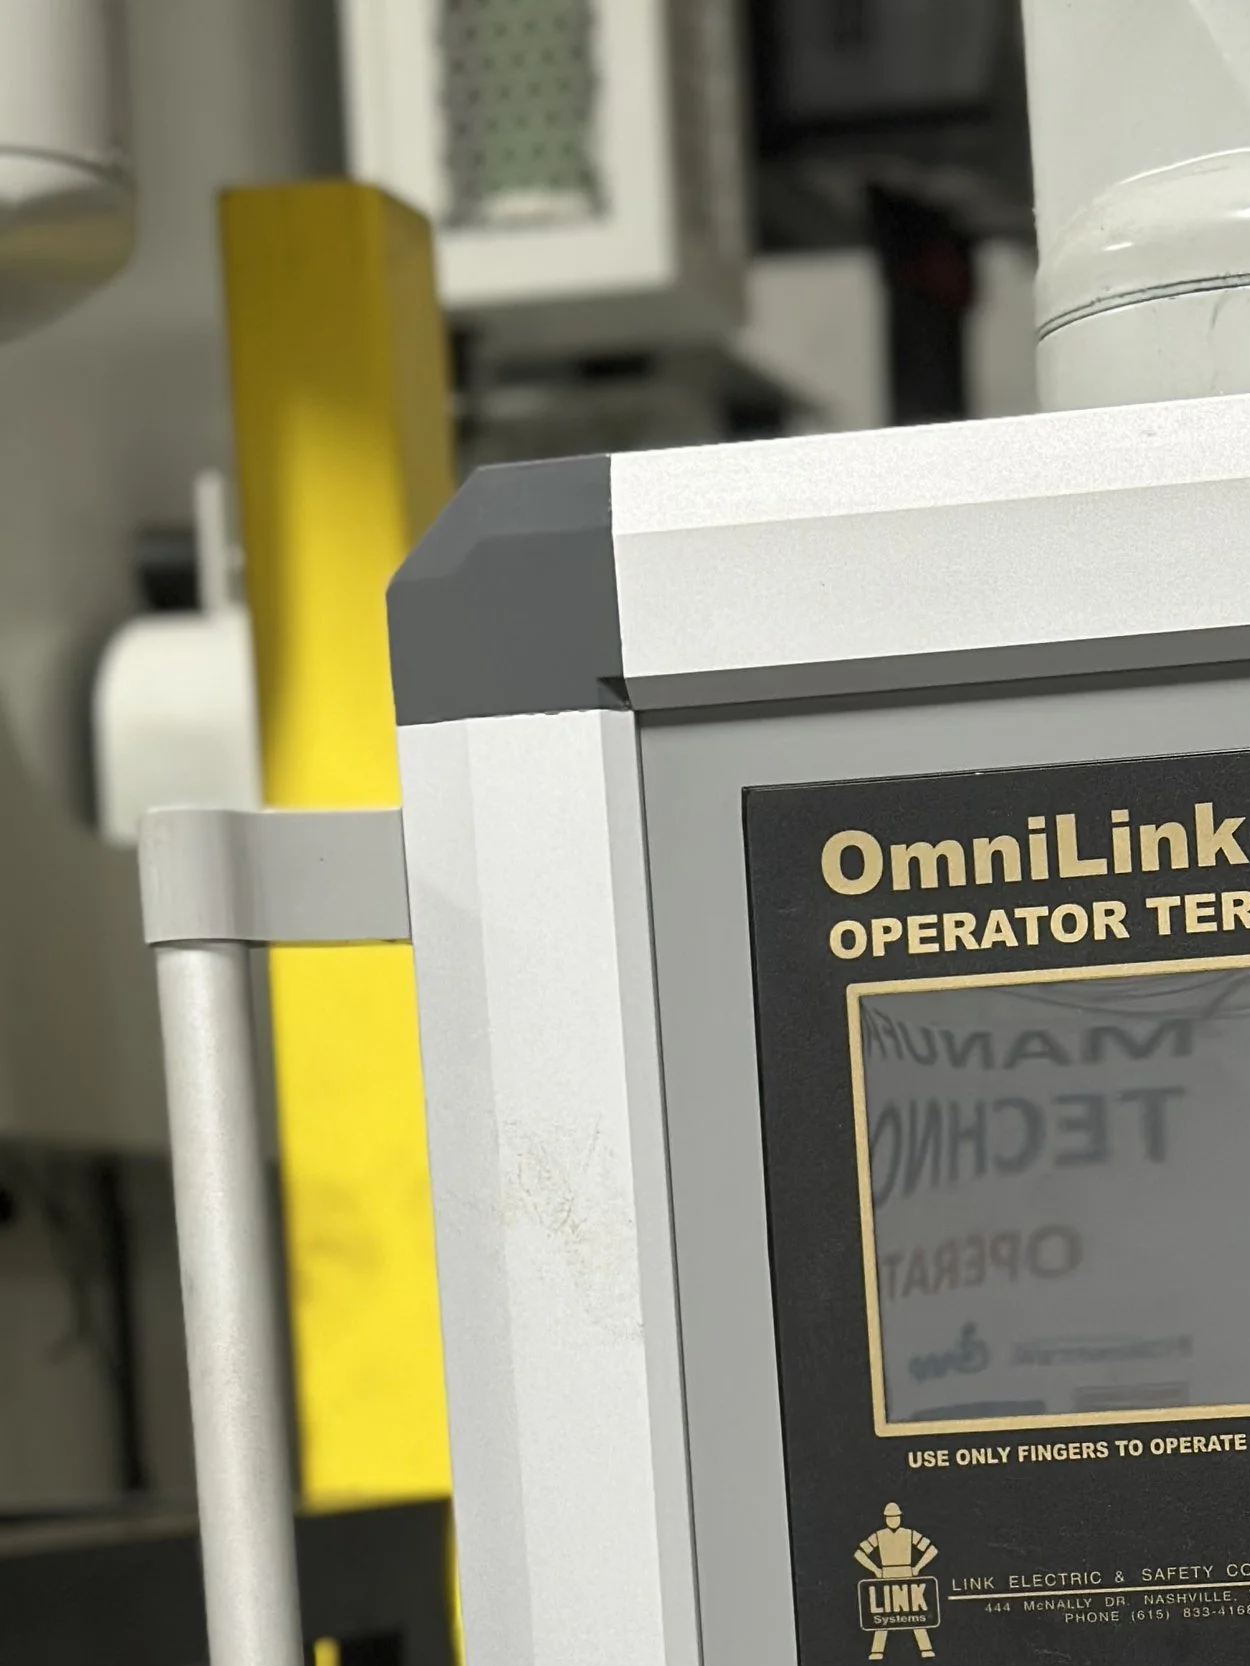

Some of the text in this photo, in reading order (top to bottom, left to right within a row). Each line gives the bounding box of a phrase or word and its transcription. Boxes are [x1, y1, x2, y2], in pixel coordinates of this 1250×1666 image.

[821, 802, 1249, 895] OmniLink
[829, 900, 1130, 959] OPERATOR
[908, 1450, 950, 1468] USE
[955, 1446, 1011, 1466] ONLY
[1017, 1441, 1109, 1463] FINGERS
[1115, 1439, 1143, 1457] TO
[1150, 1434, 1247, 1455] OPERATE
[952, 1576, 995, 1591] LINK
[1009, 1571, 1102, 1588] ELECTRIC
[1114, 1571, 1125, 1583] &
[1142, 1565, 1214, 1582] SAFETY
[869, 1584, 928, 1613] LINK
[984, 1602, 1011, 1614] 444
[1023, 1598, 1092, 1611] McNALLY
[1105, 1596, 1131, 1608] DR.
[873, 1615, 927, 1626] Systems
[1065, 1611, 1120, 1623] PHONE
[1131, 1609, 1170, 1623] (615)
